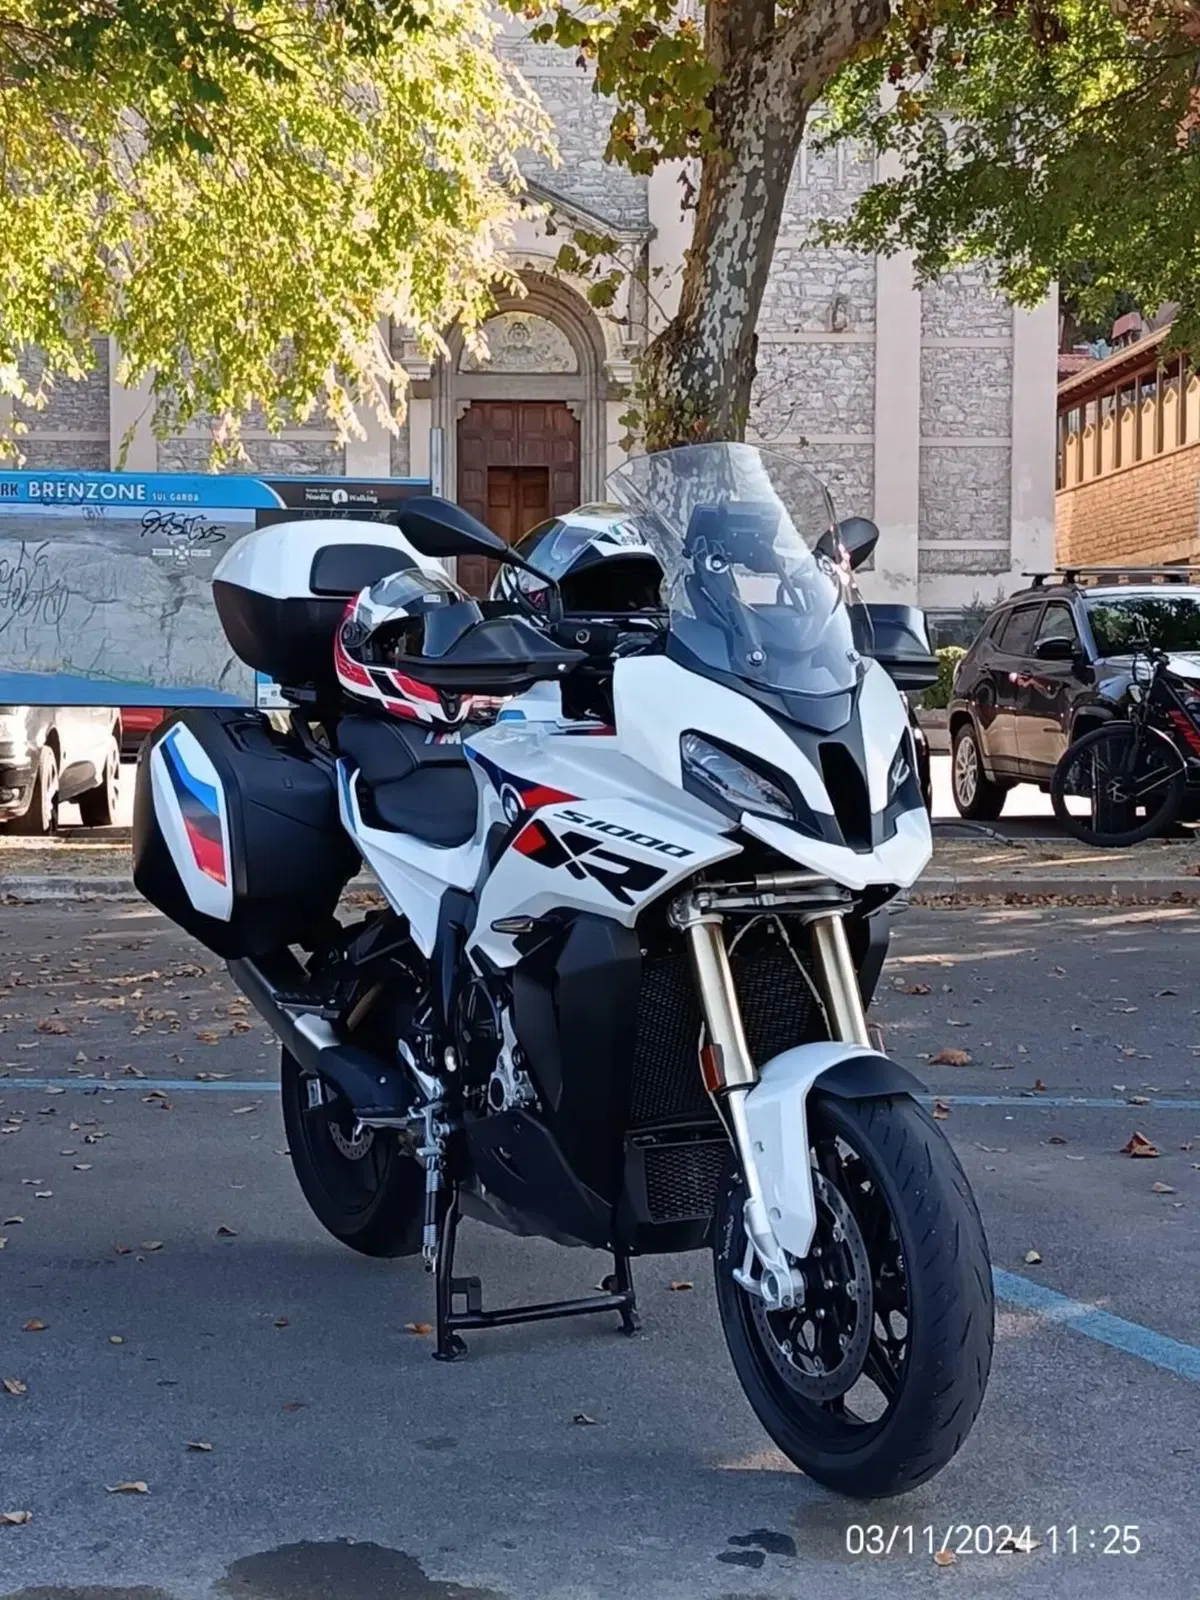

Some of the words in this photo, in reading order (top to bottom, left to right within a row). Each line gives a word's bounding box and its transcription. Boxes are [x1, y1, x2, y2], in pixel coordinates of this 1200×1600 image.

[28, 481, 146, 500] BRENZONE
[349, 494, 378, 504] Walking
[553, 809, 696, 859] S1000
